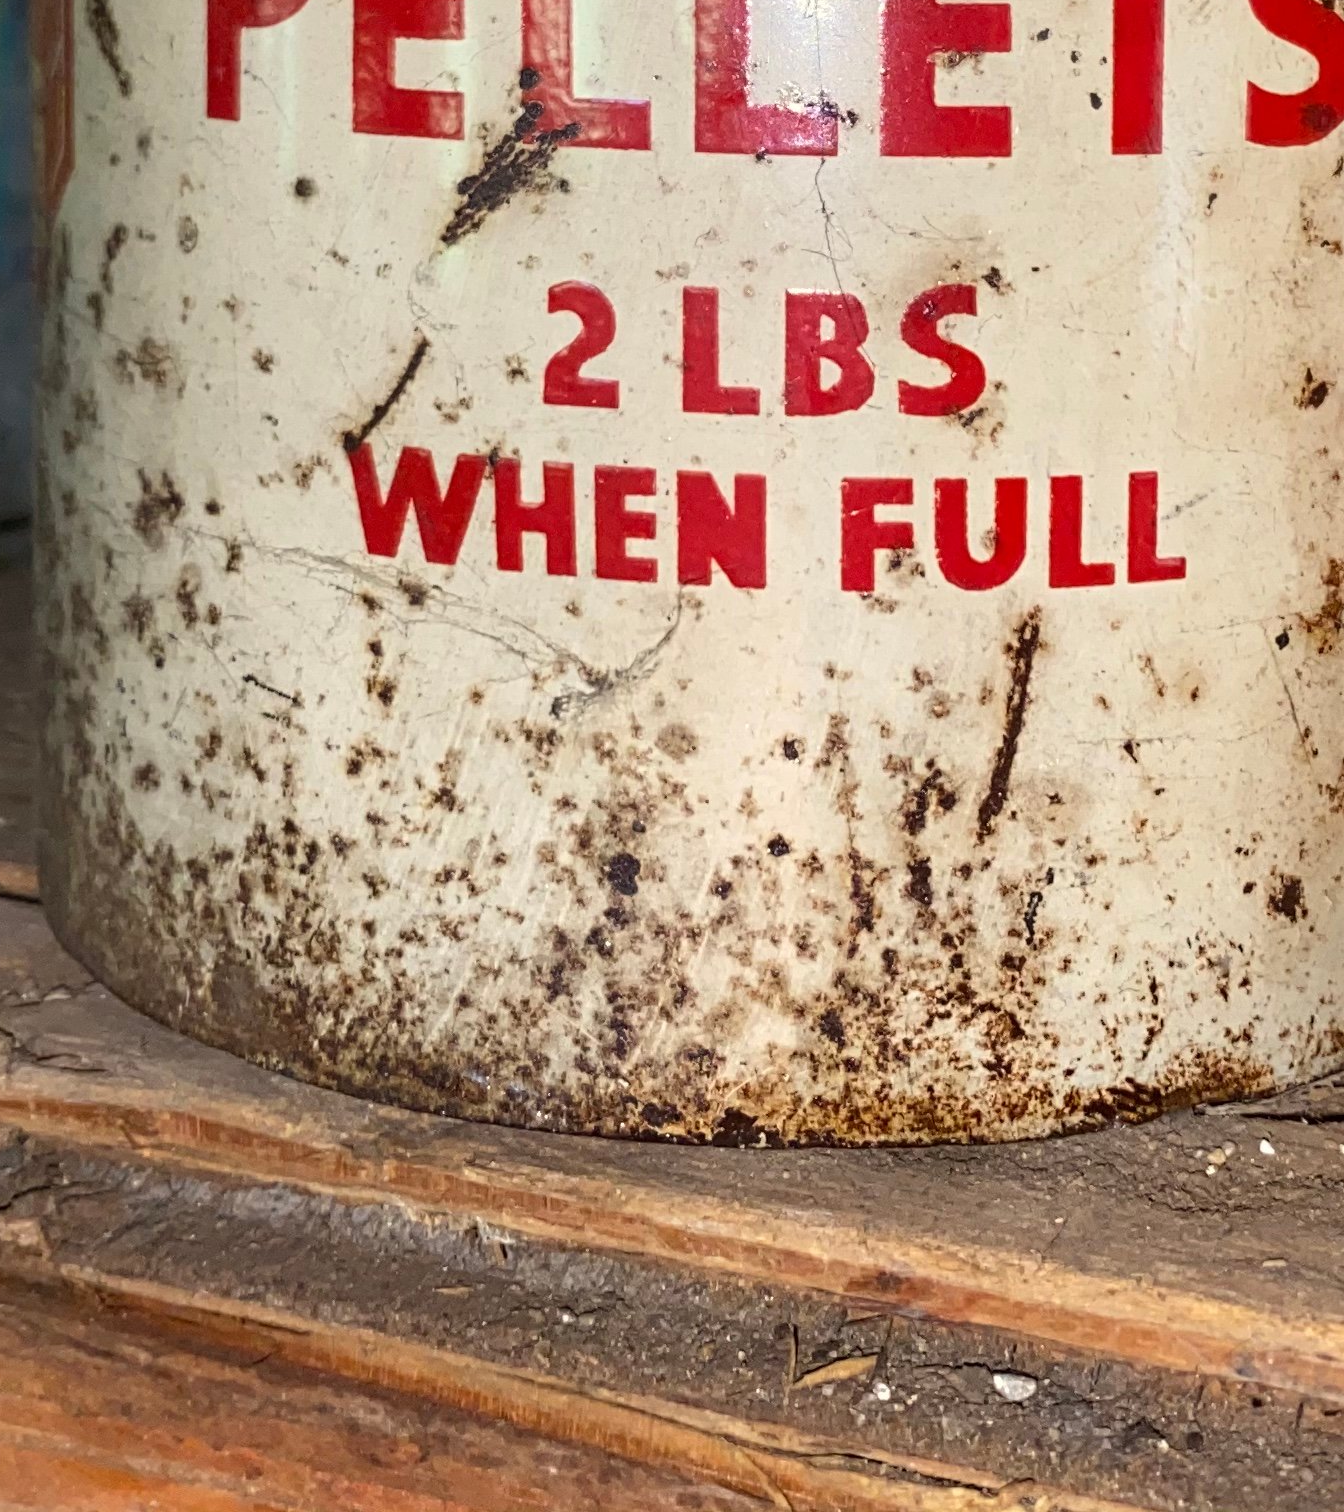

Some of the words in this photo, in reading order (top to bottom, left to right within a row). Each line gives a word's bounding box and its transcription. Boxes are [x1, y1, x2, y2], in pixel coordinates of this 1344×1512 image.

[541, 279, 621, 410] 2
[680, 283, 988, 418] LBS
[348, 442, 769, 591] WHEN
[839, 471, 1188, 594] FULL
